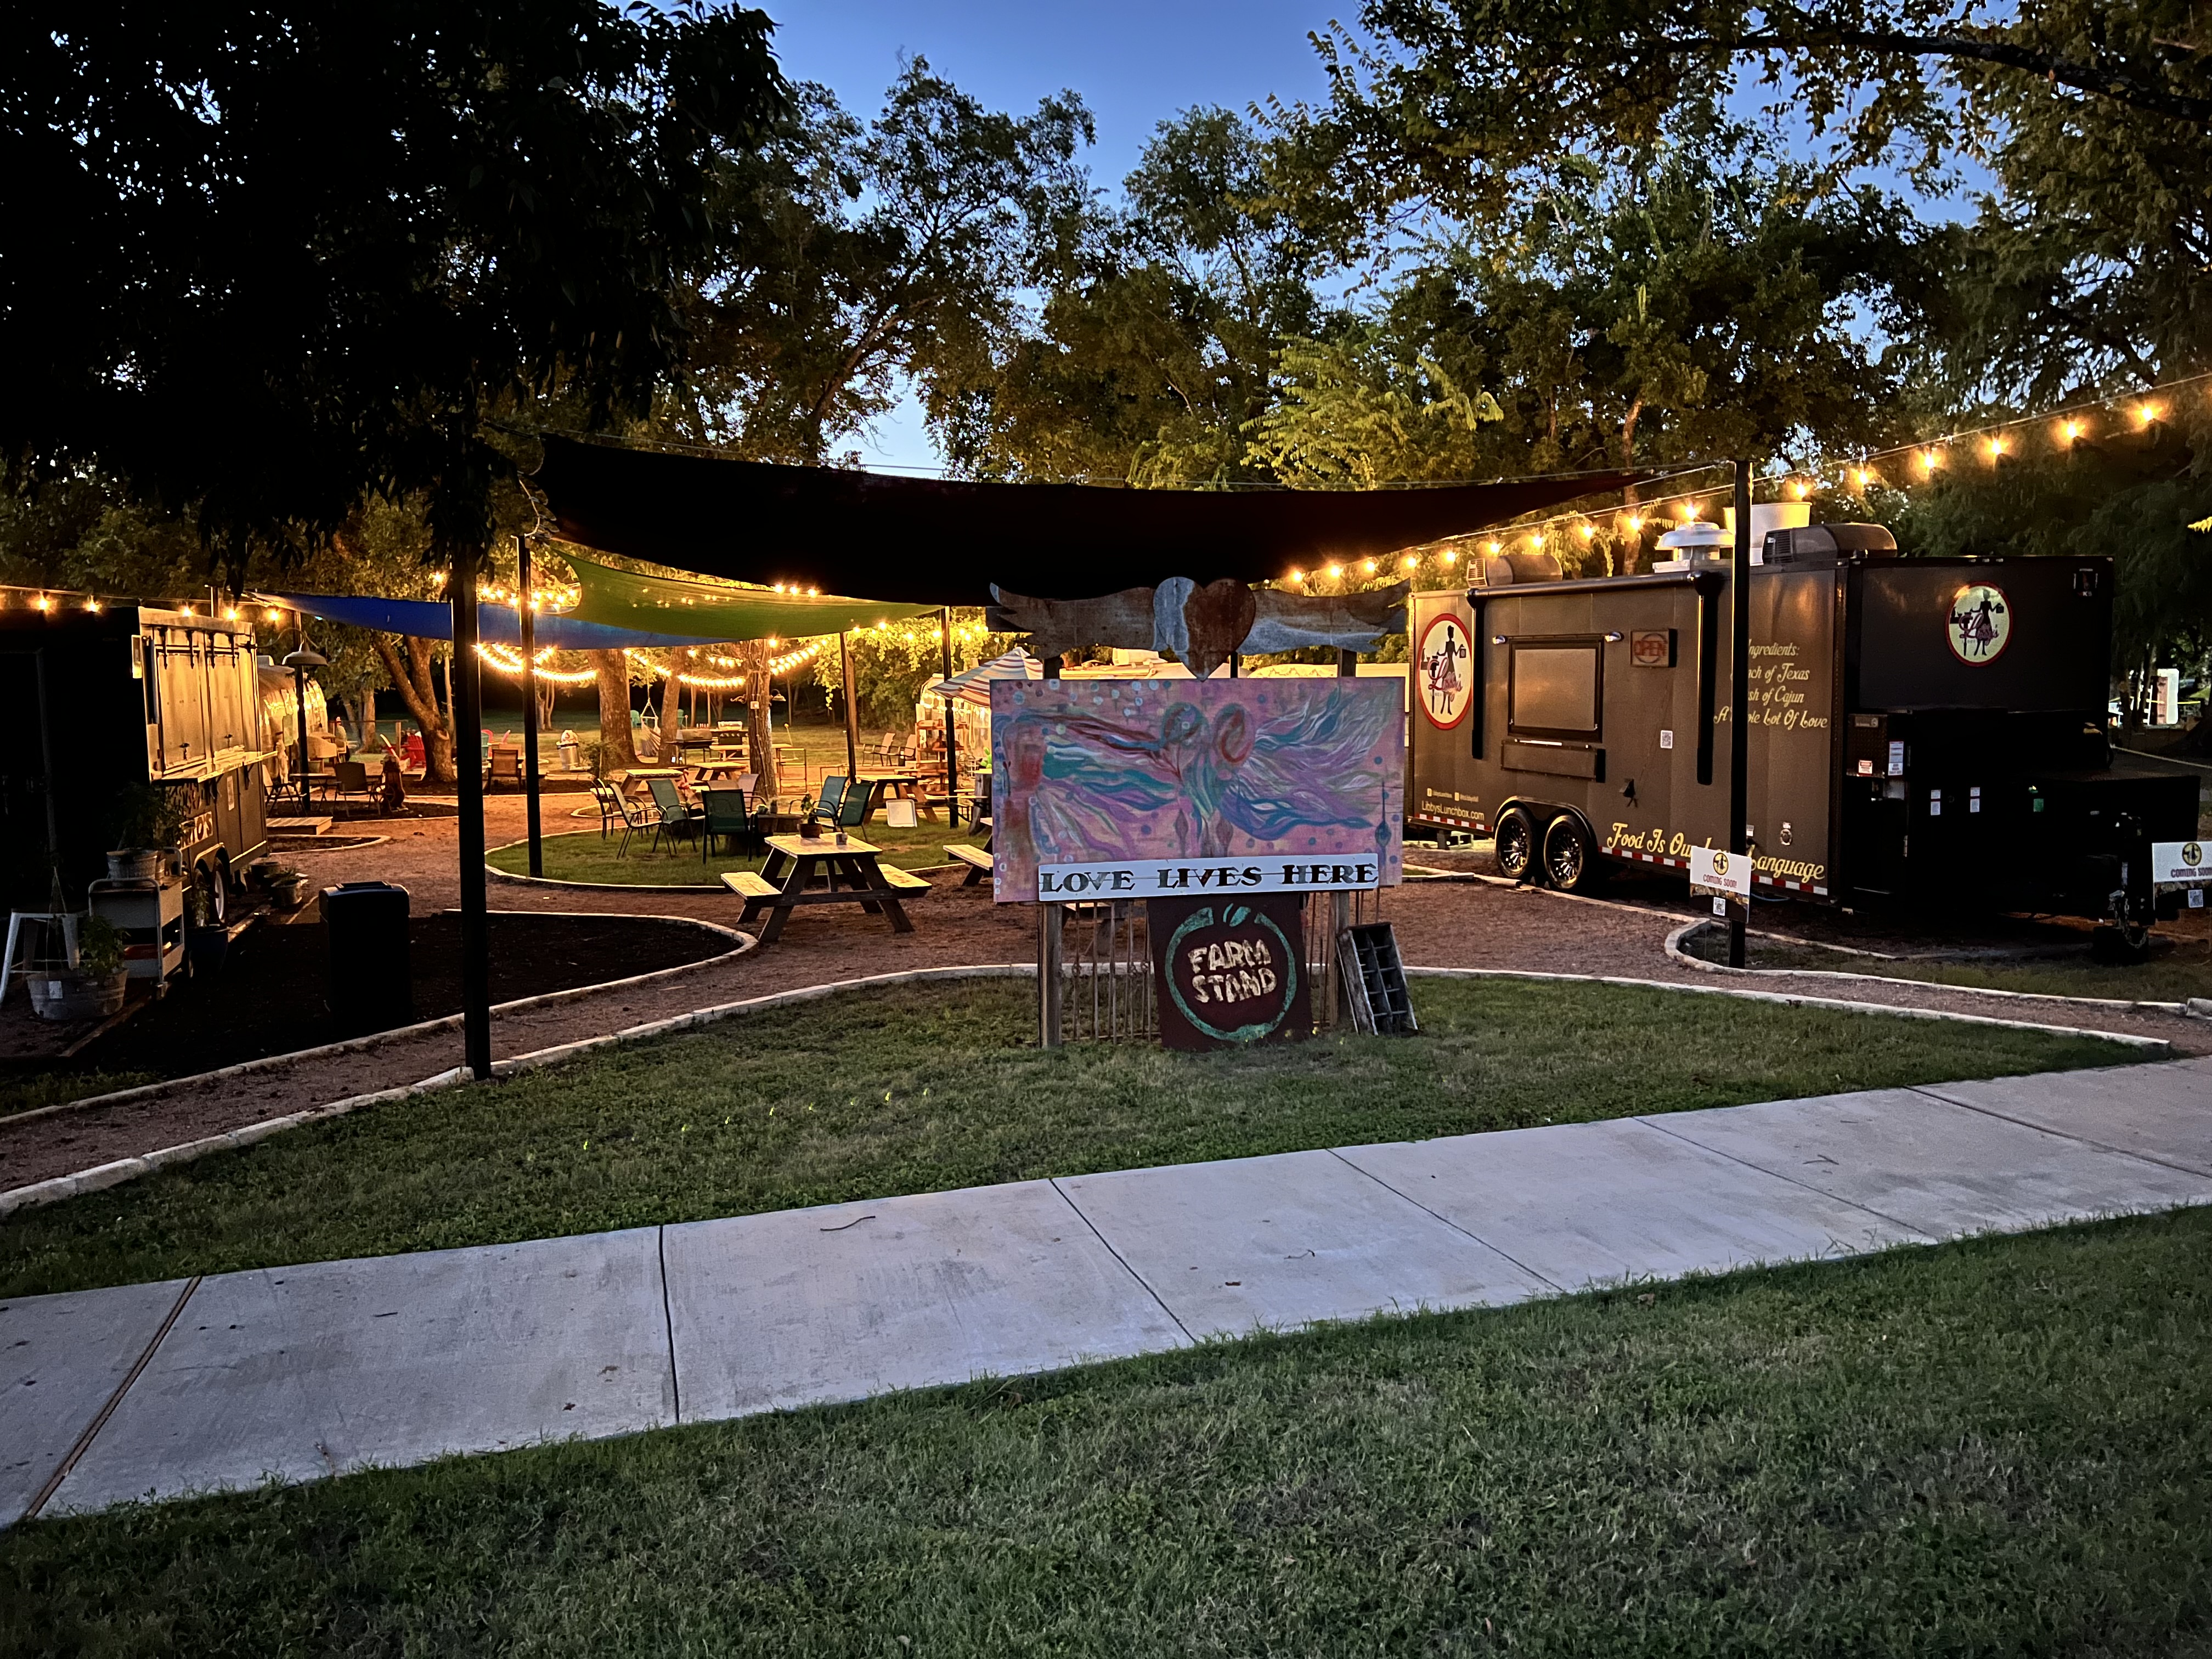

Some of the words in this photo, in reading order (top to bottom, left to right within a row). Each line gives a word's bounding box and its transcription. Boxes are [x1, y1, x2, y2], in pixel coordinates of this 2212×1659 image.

[1634, 640, 1667, 657] OPEN
[1764, 665, 1778, 684] of
[1777, 663, 1810, 683] Texas
[1762, 687, 1775, 706] of
[1774, 685, 1805, 708] Cajun
[1713, 706, 1730, 724] A
[1763, 708, 1782, 726] Lot
[1784, 709, 1800, 731] Of
[1799, 710, 1828, 729] Love
[1421, 800, 1485, 821] LibbysLunchbox.com
[1607, 822, 1646, 849] Food
[1646, 829, 1666, 853] Is
[1669, 832, 1691, 858] Ou
[1040, 870, 1136, 894] LOVE
[1156, 866, 1262, 889] LIVES
[1281, 863, 1379, 886] HERE
[1703, 874, 1722, 885] COMING
[1723, 878, 1737, 888] SOON!
[2170, 868, 2197, 878] COMING
[1188, 939, 1272, 974] FARM
[1192, 968, 1277, 1003] STAND
